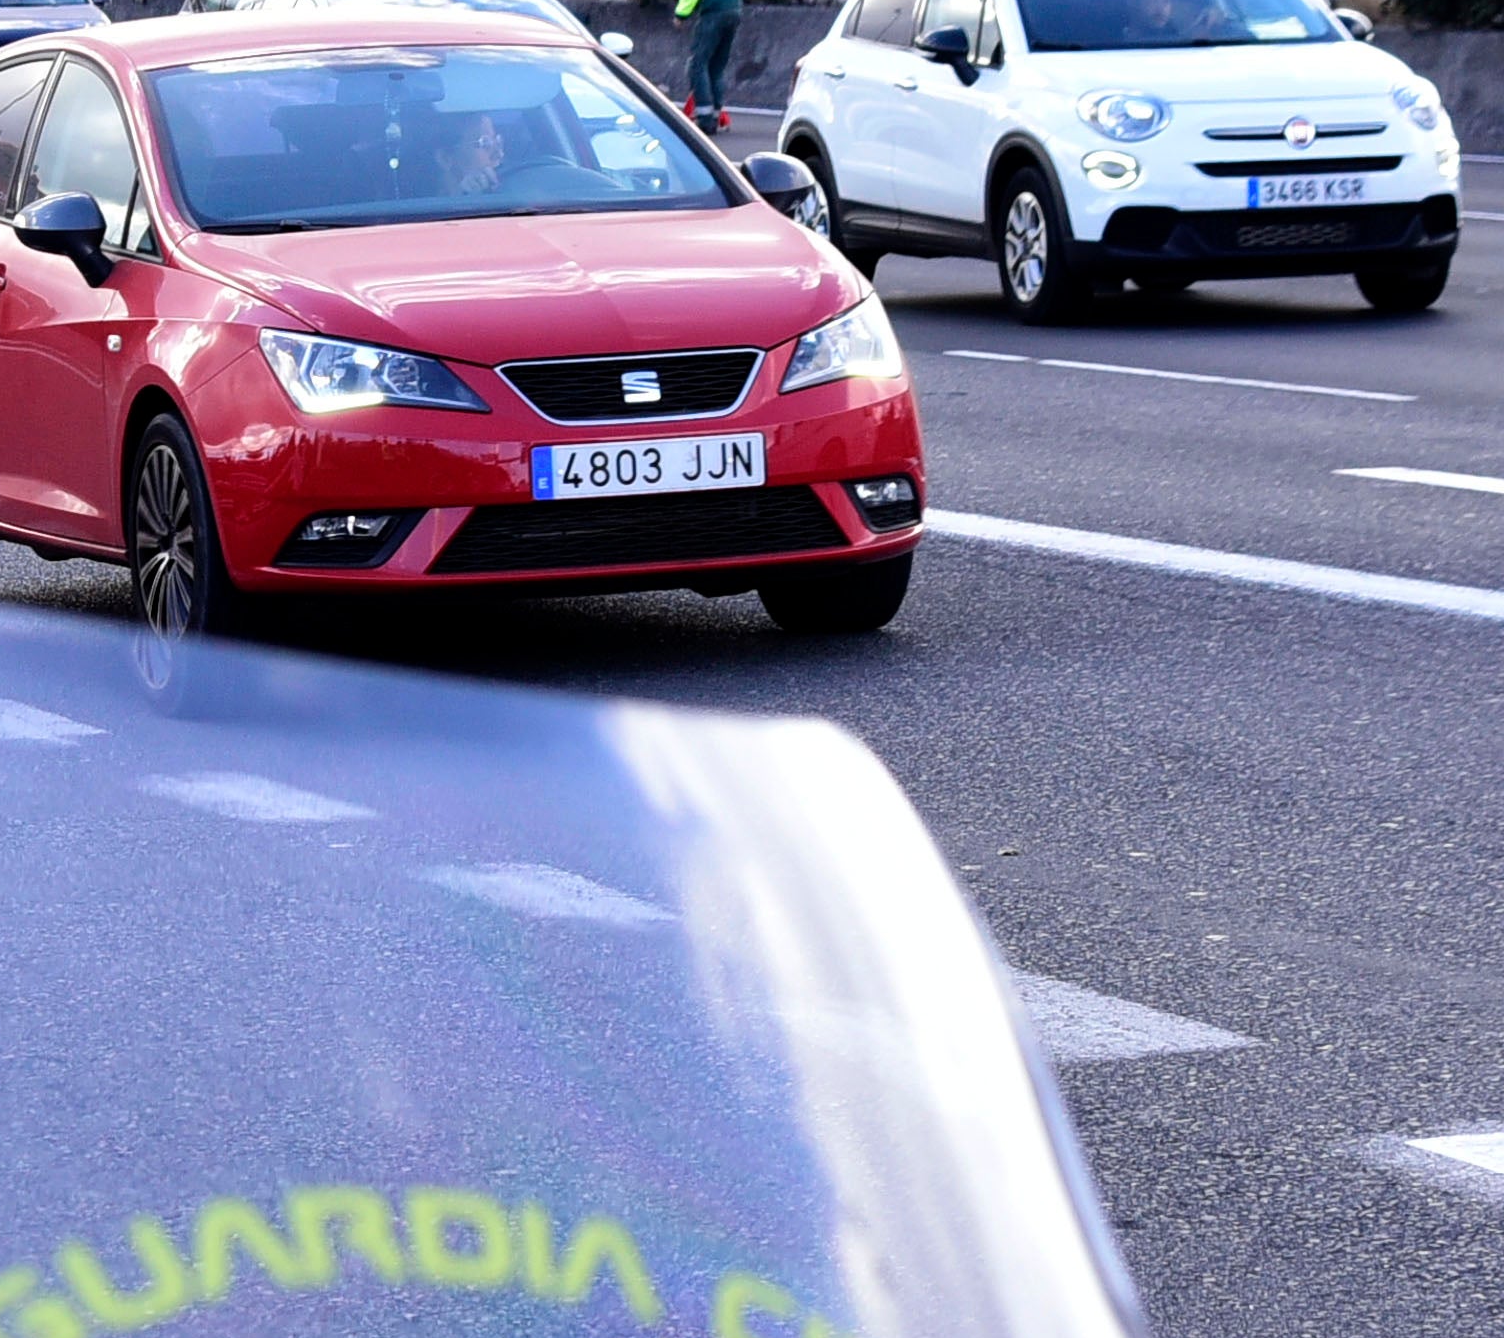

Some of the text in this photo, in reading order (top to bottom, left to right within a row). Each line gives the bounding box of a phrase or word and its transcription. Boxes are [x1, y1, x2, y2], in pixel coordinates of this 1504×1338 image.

[1323, 177, 1365, 200] KSR
[537, 440, 753, 489] E 4803 JJN
